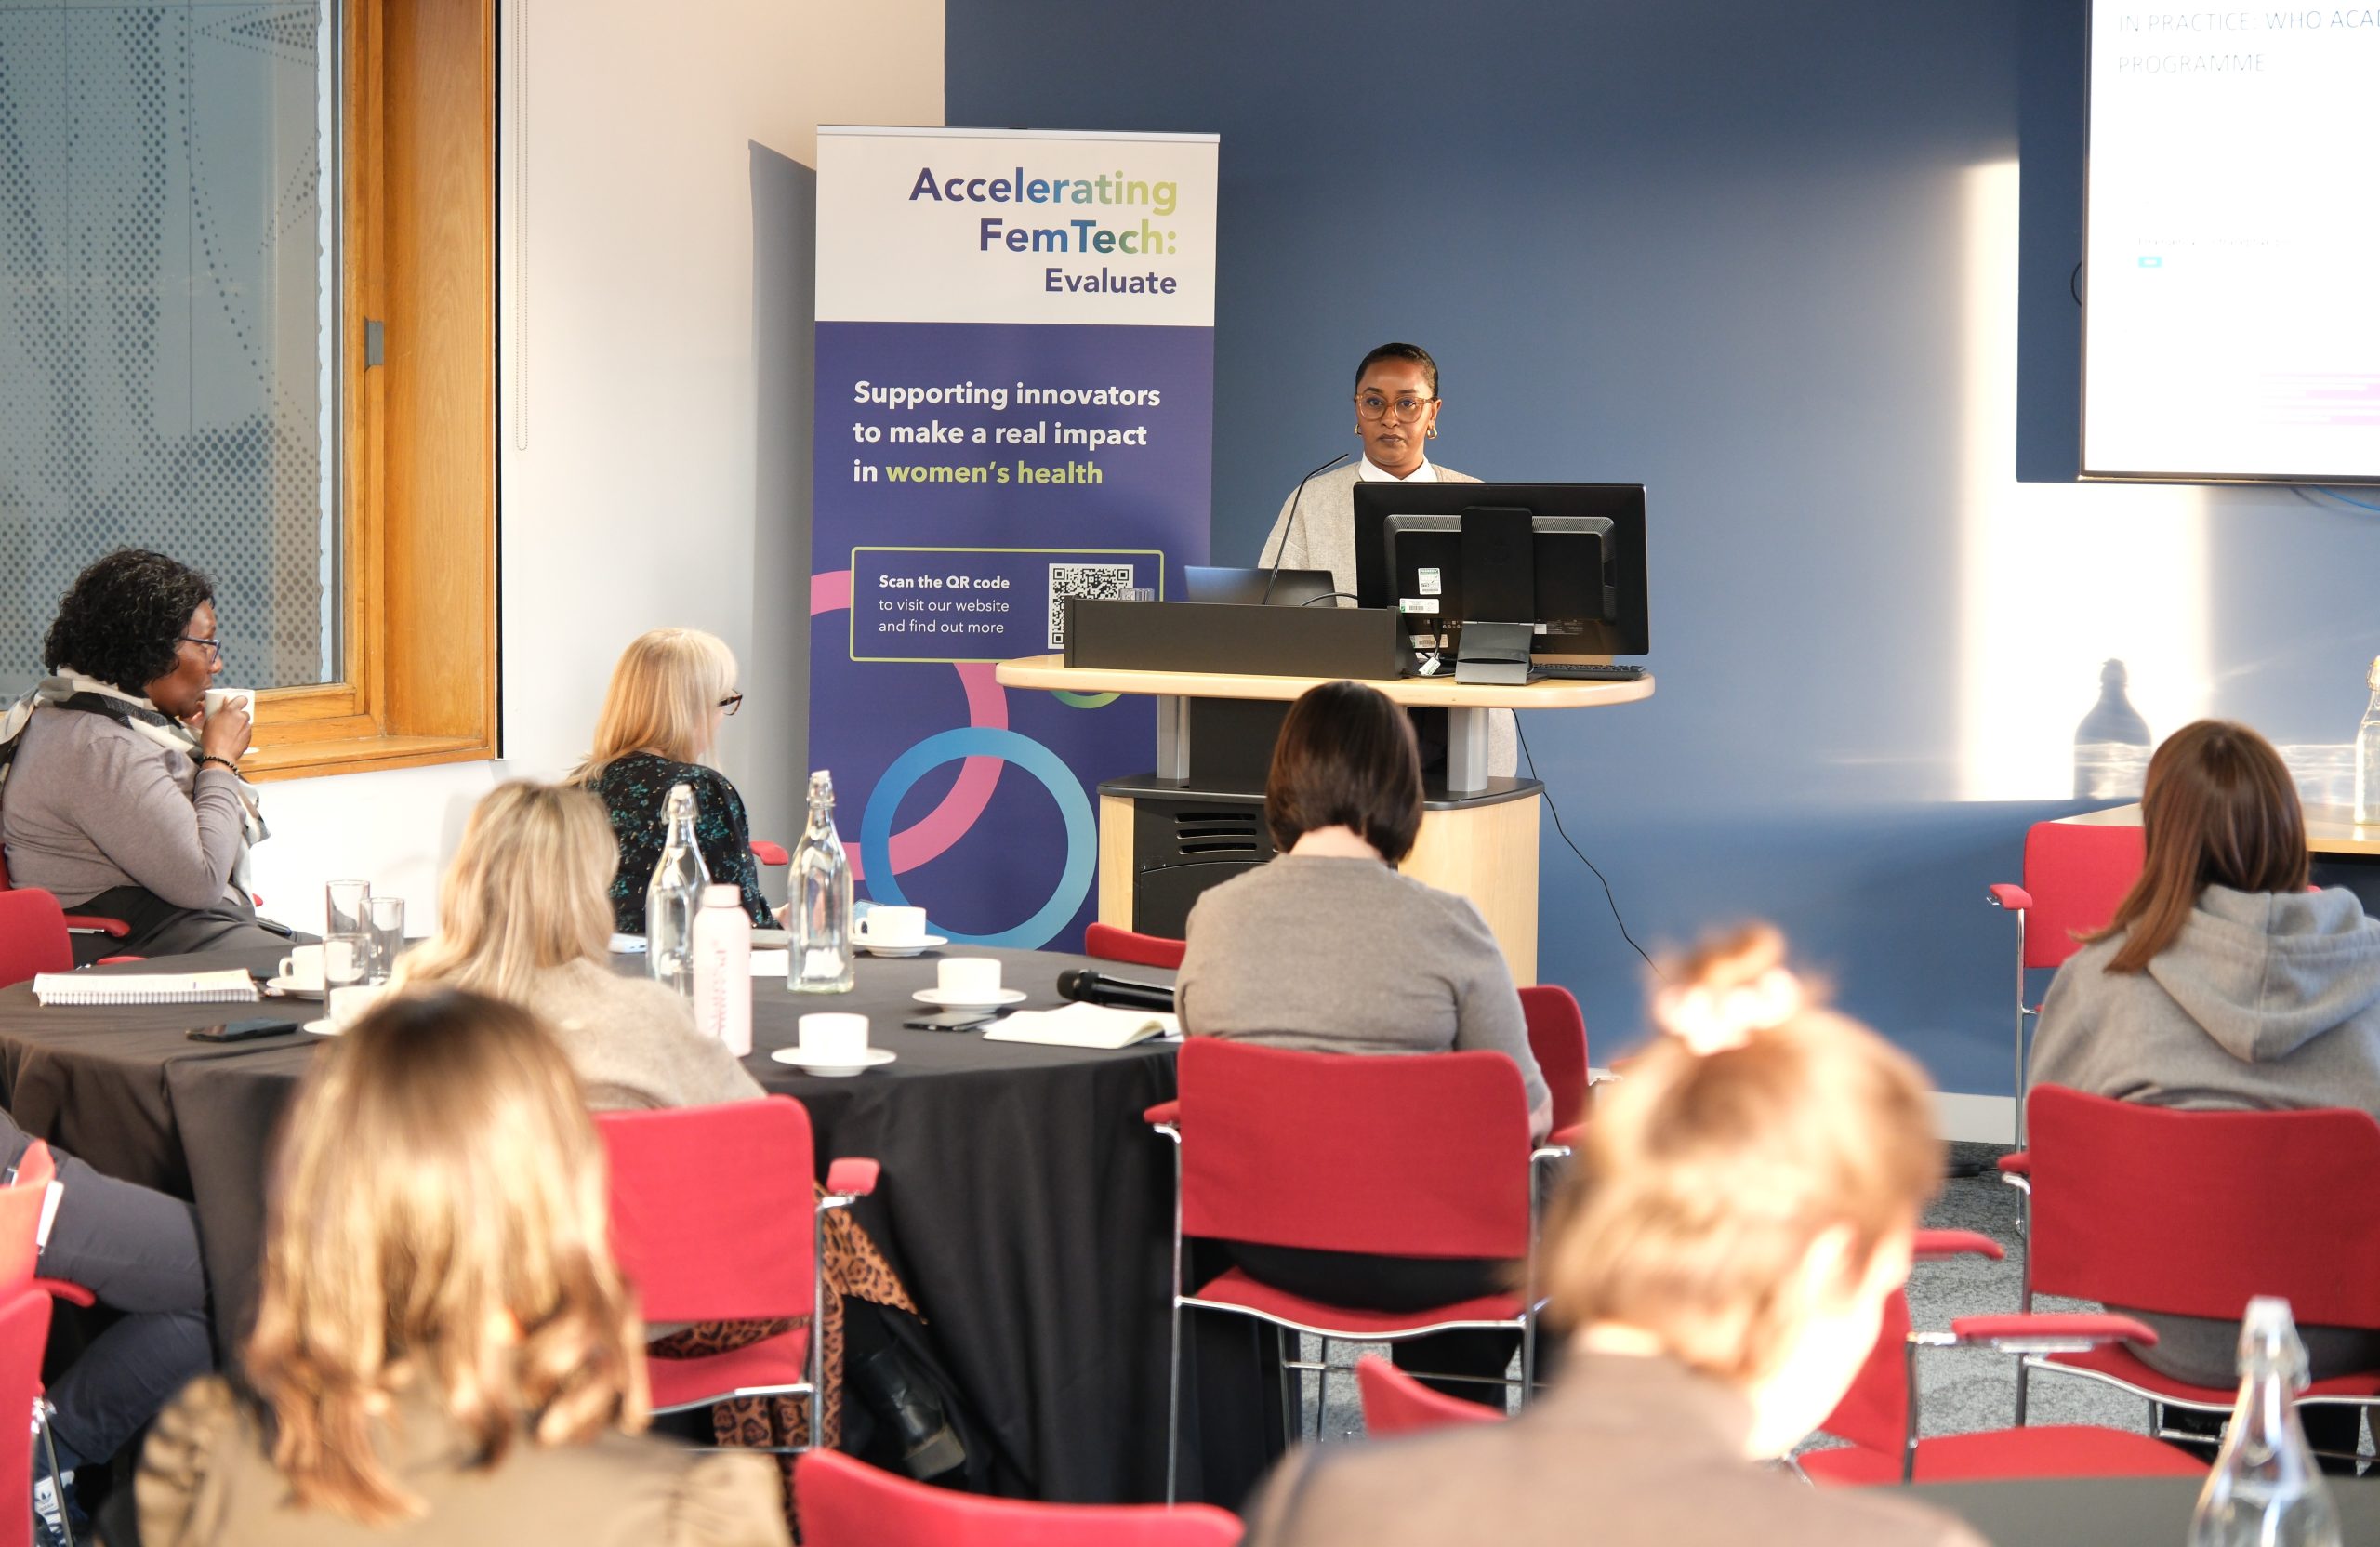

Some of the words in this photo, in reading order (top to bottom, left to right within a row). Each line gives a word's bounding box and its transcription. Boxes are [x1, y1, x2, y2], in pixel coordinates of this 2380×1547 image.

[2119, 15, 2140, 32] IN
[2266, 9, 2321, 30] WHO
[2330, 8, 2380, 30] ACA
[2119, 53, 2266, 74] PROGRAMME
[909, 167, 1177, 216] Accelerating
[980, 218, 1176, 254] FemTech:
[1046, 267, 1176, 294] Evaluate
[853, 380, 1009, 411] Supporting
[1016, 381, 1161, 407] innovators
[853, 422, 882, 443] to
[889, 419, 965, 443] make
[972, 427, 987, 443] a
[995, 420, 1046, 444] real
[1054, 421, 1148, 452] impact
[853, 458, 879, 483] in
[1017, 460, 1103, 484] health
[879, 574, 915, 588] Scan
[917, 574, 943, 588] the
[945, 575, 970, 588] QR
[972, 575, 1011, 589] code
[878, 599, 893, 611] to
[896, 598, 925, 612] visit
[927, 602, 952, 612] our
[955, 598, 1010, 613] website
[879, 618, 906, 632] and
[908, 618, 936, 633] find
[940, 621, 964, 633] out
[968, 623, 1005, 634] more
